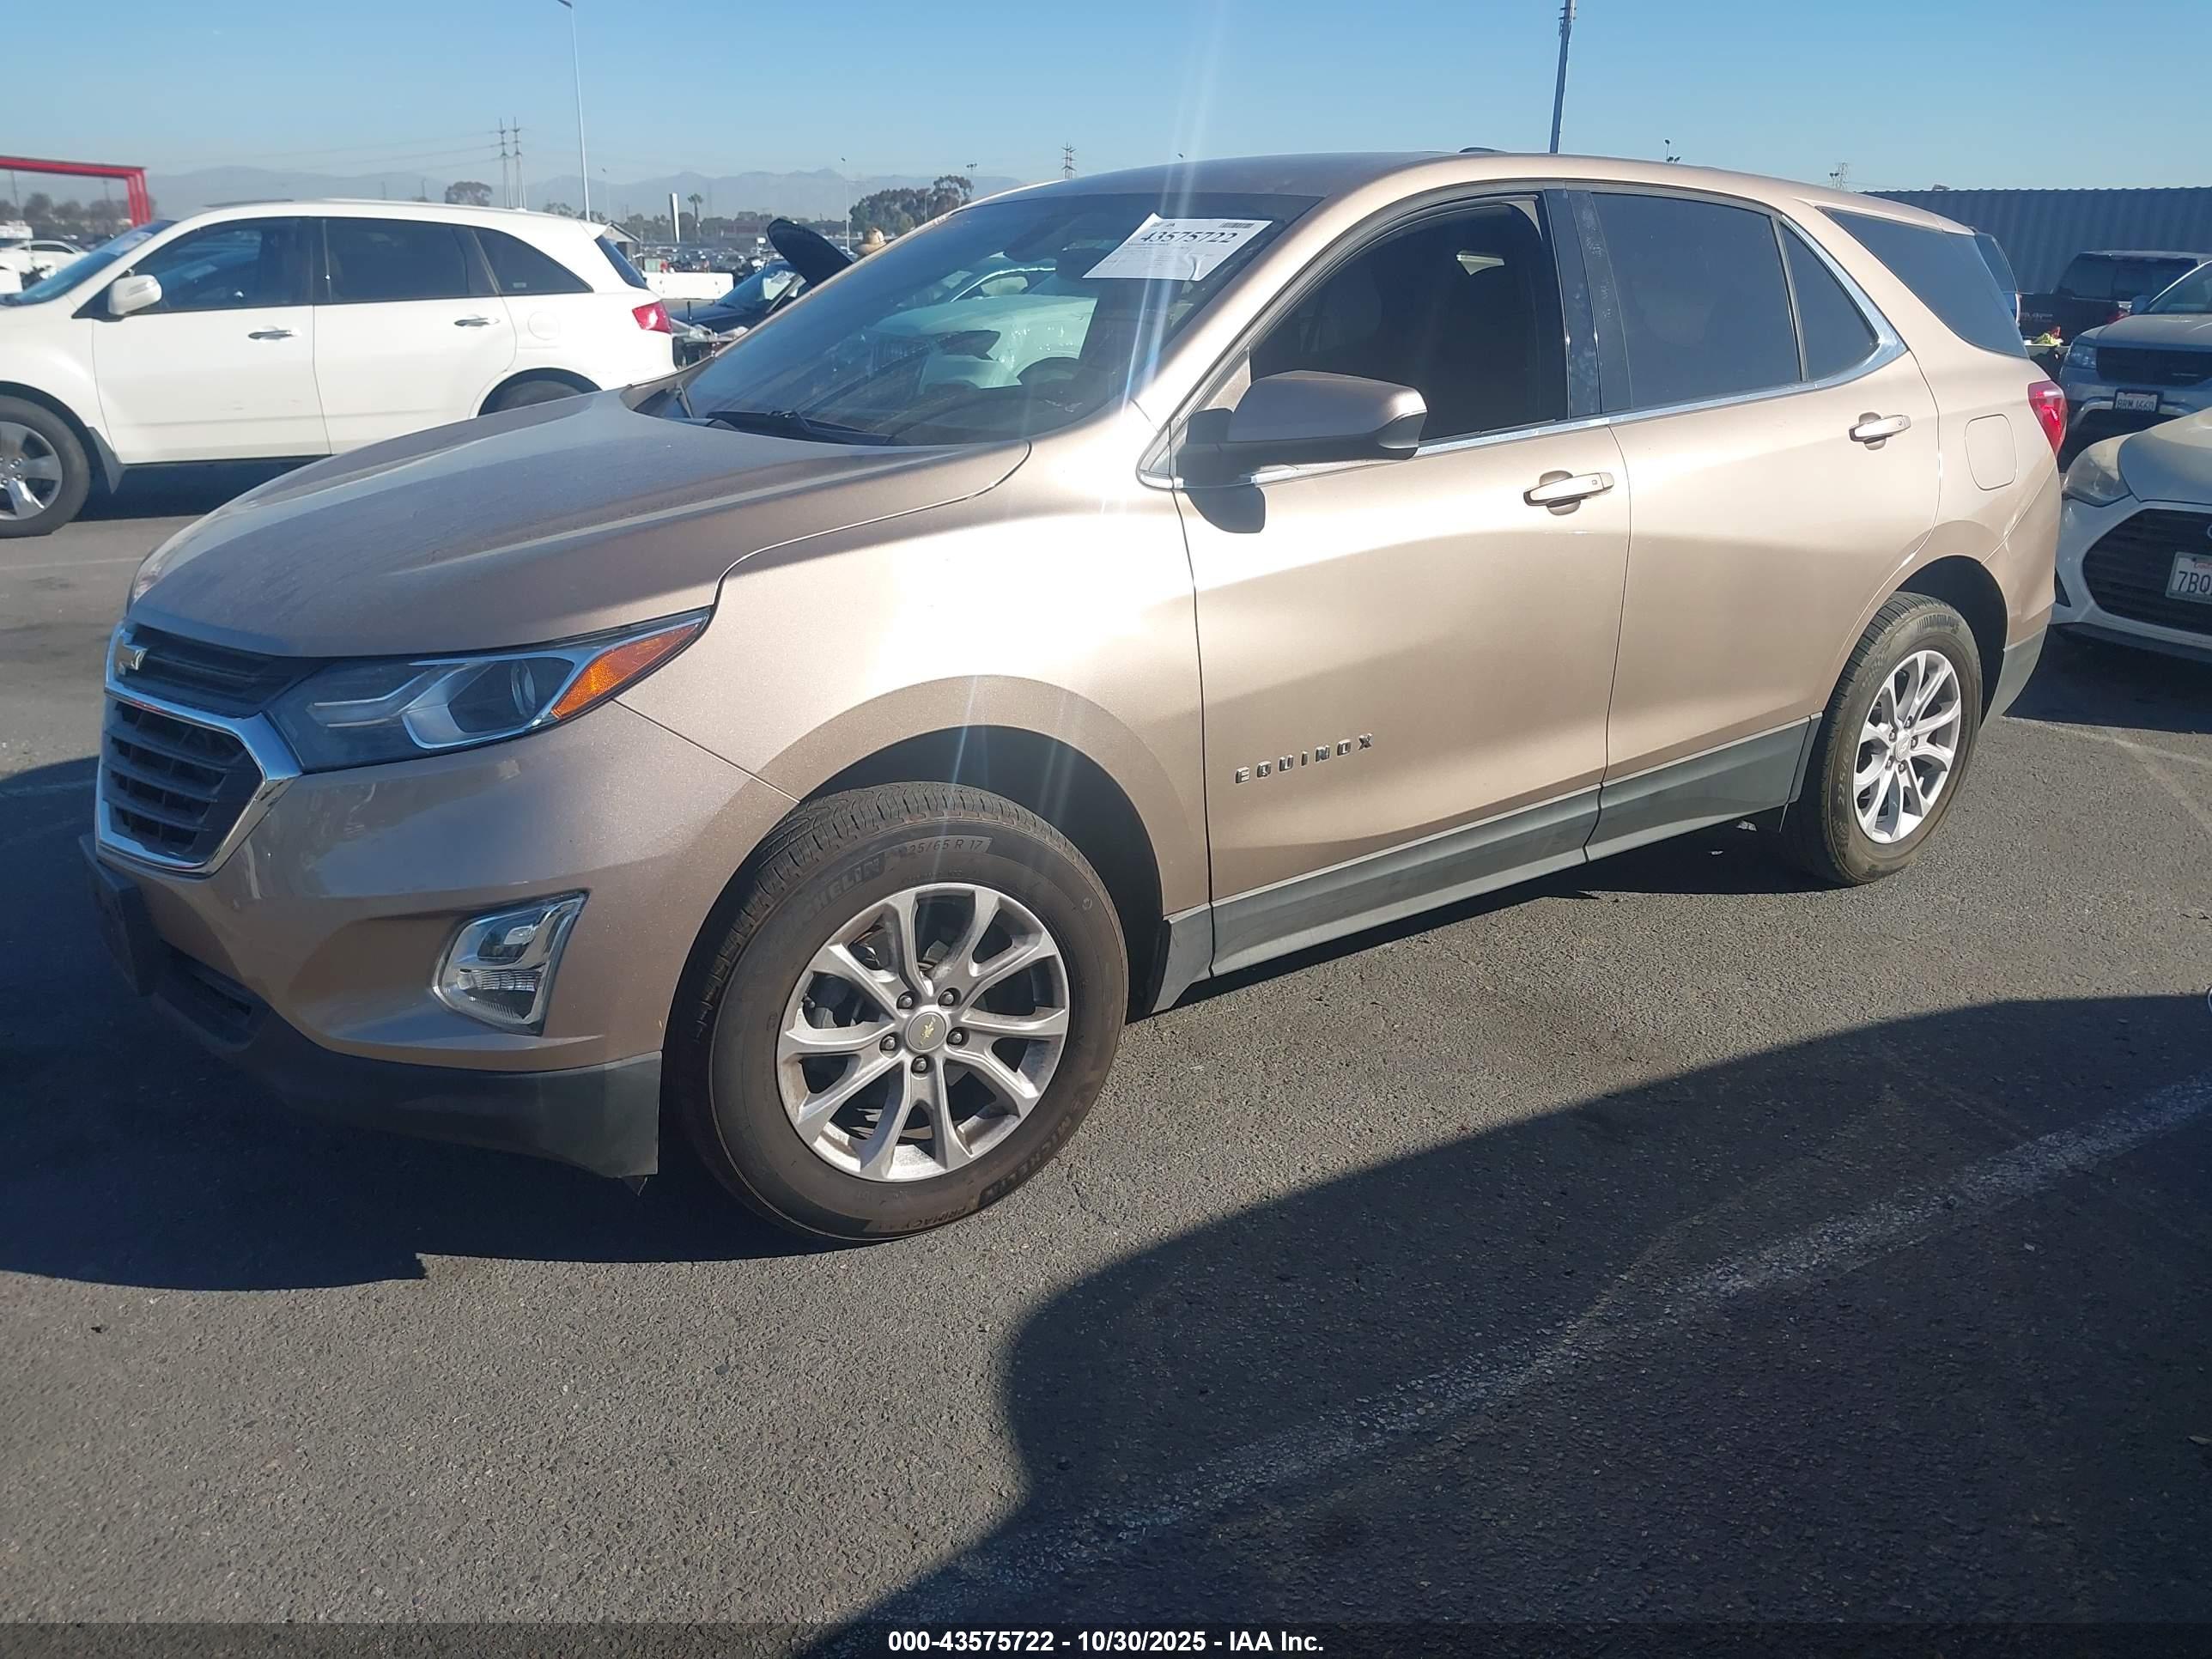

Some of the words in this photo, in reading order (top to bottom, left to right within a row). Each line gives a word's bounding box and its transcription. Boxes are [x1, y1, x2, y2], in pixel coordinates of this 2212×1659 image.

[1139, 230, 1239, 244] 43575722
[1235, 732, 1373, 784] EQUINOX
[954, 839, 965, 850] R
[969, 839, 983, 852] 17
